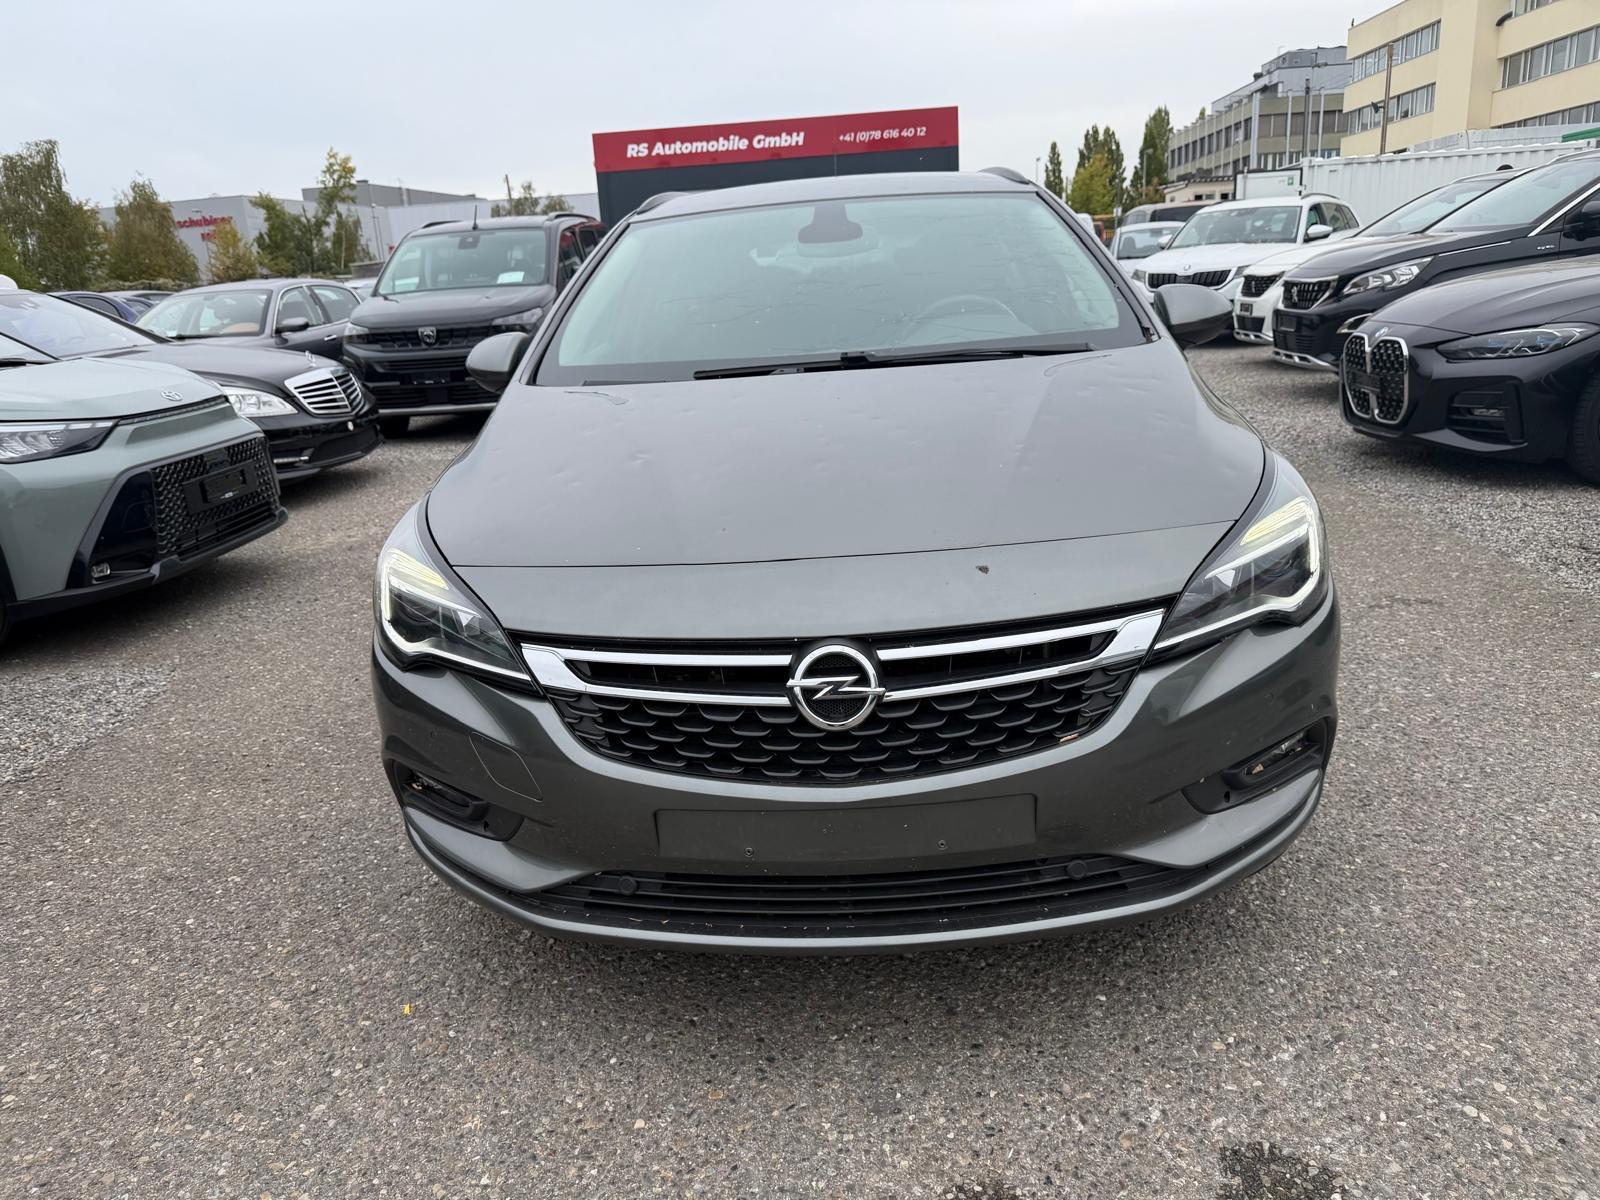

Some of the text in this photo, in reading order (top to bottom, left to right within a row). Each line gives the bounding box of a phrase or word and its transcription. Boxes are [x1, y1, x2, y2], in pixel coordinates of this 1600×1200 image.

[627, 131, 805, 158] RS Automobile GmbH
[838, 126, 927, 143] +41 (0)78 616 40 12
